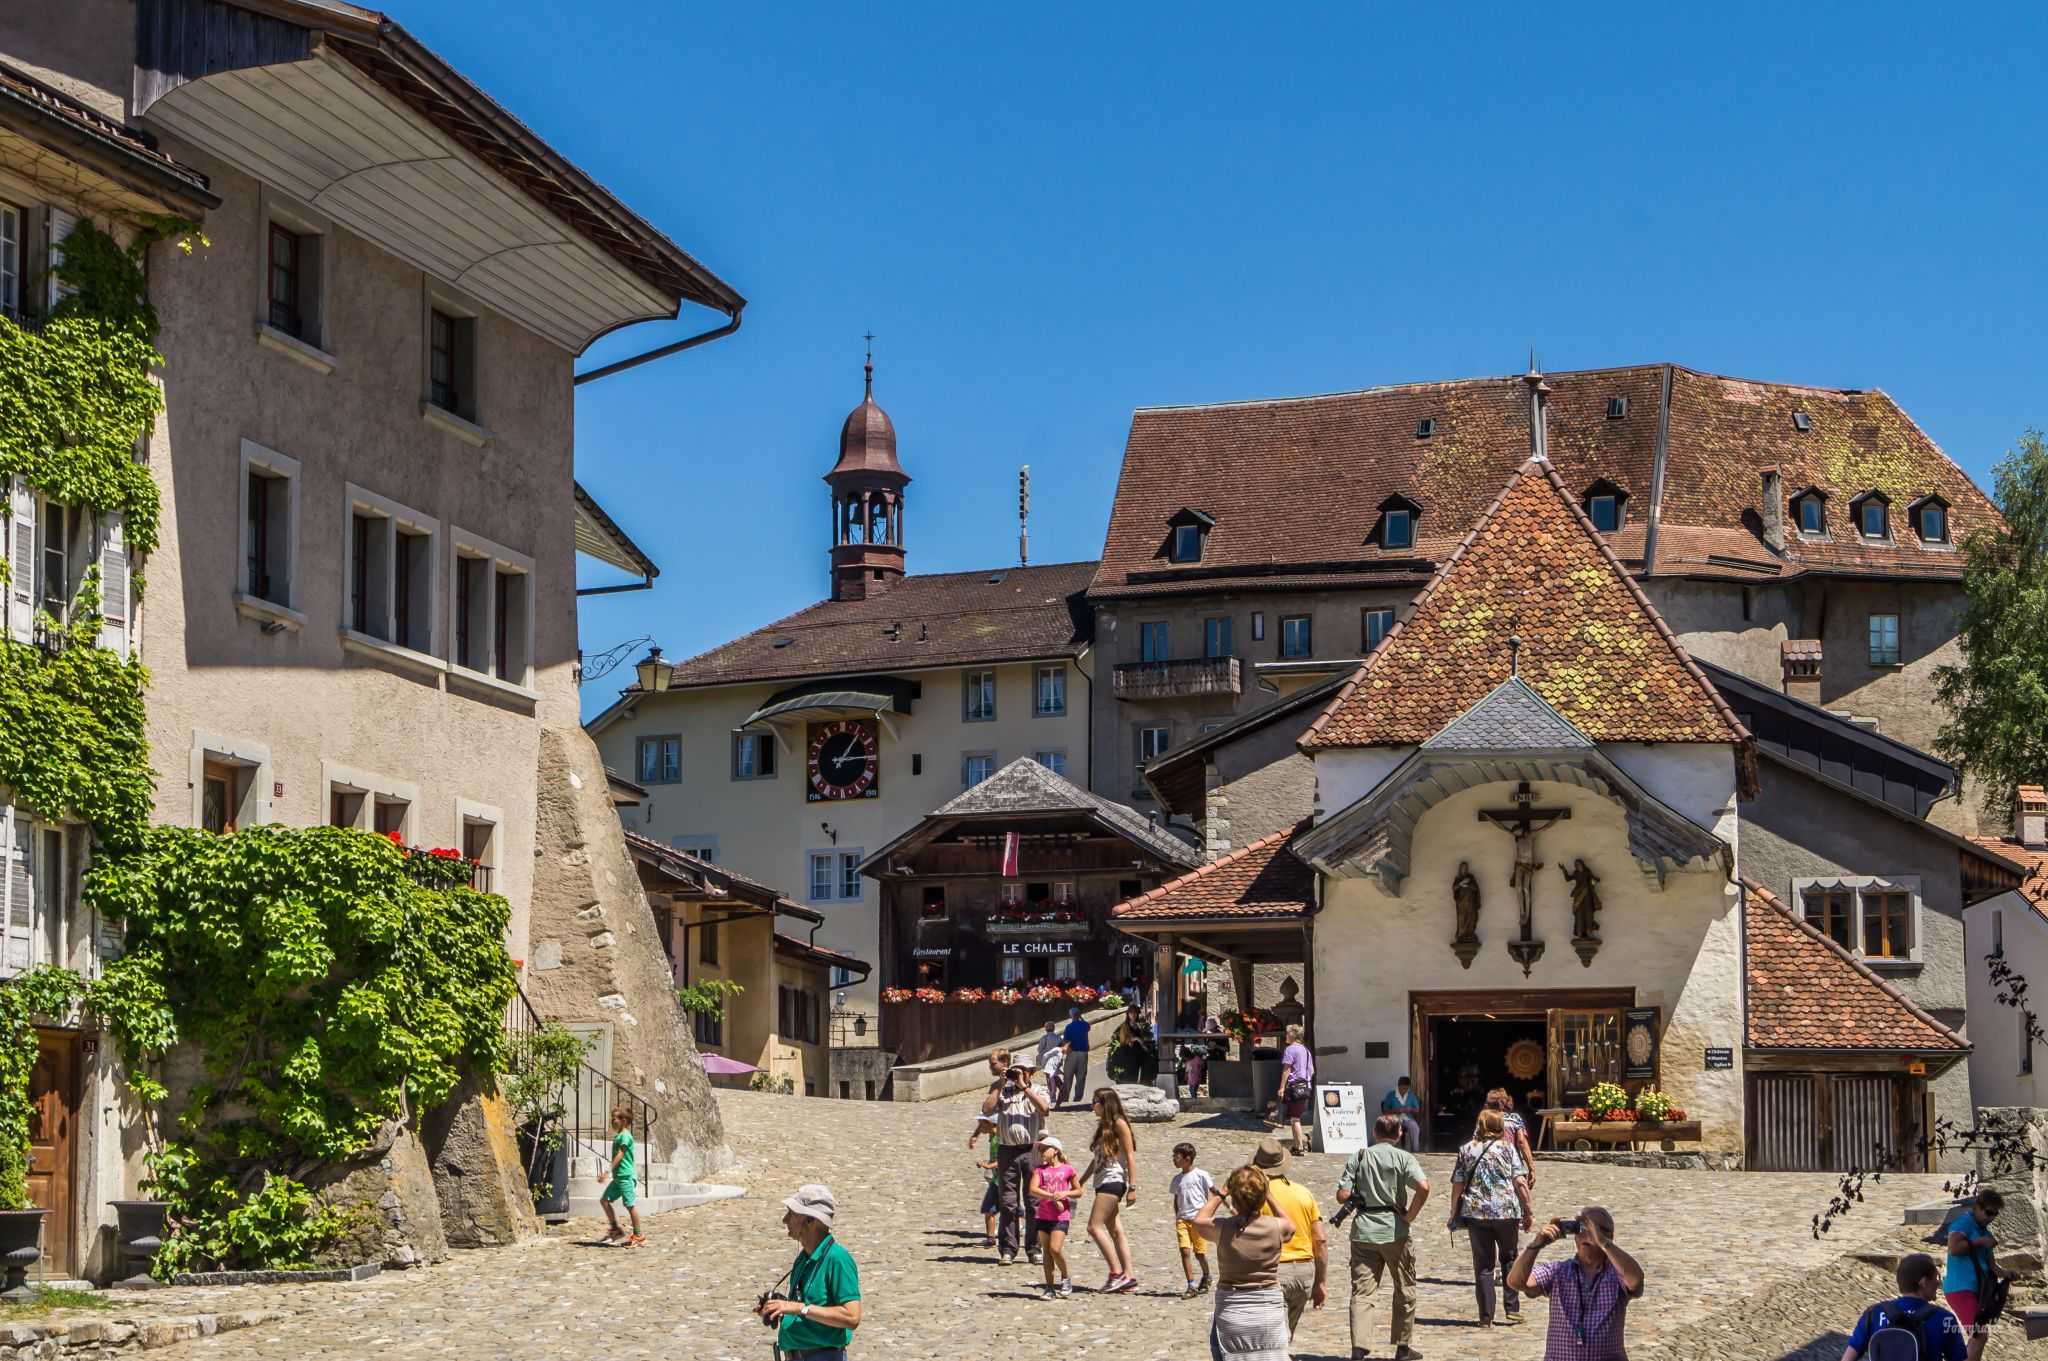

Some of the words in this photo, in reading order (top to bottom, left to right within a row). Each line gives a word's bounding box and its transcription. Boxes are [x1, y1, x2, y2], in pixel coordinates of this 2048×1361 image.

[912, 947, 952, 956] Restaurant
[1003, 944, 1020, 954] LE
[1024, 943, 1073, 953] CHALET
[85, 1041, 95, 1051] 31
